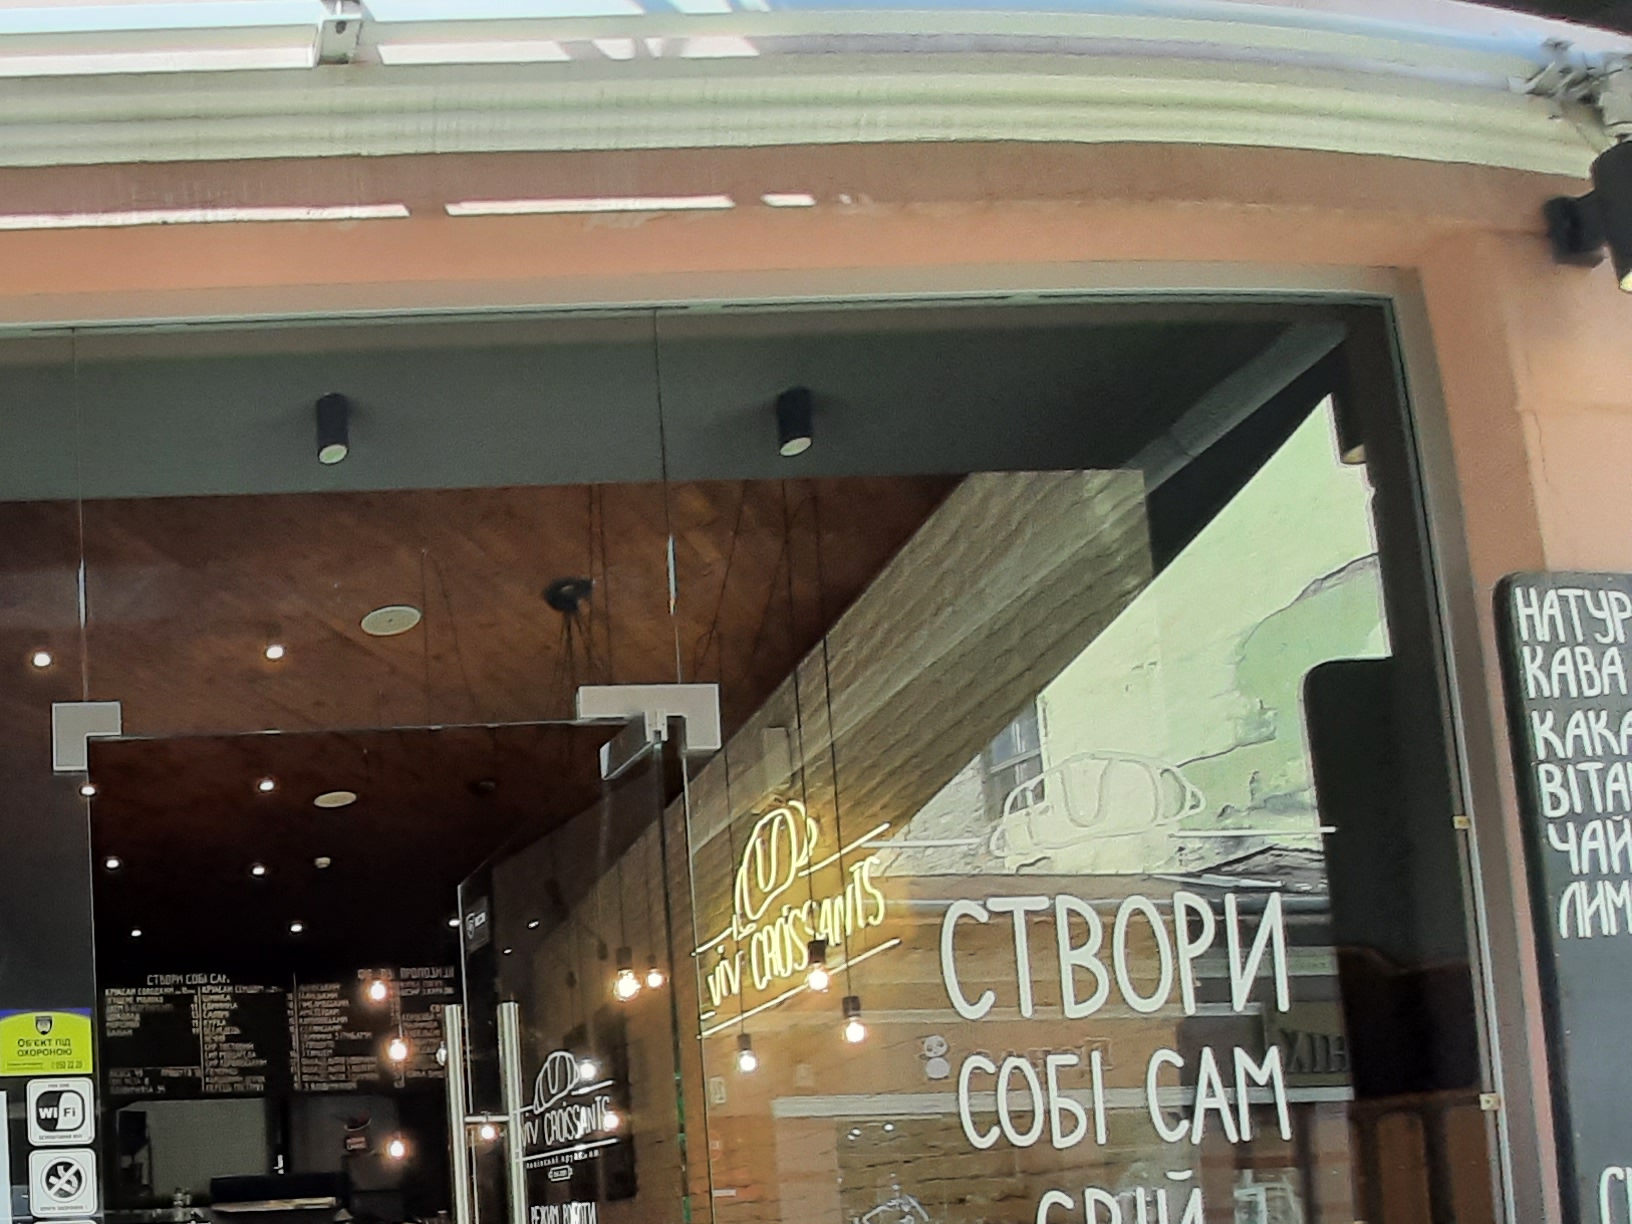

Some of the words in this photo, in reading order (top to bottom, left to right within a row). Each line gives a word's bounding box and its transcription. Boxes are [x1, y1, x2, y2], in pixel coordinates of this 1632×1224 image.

[1522, 646, 1628, 700] КАВА
[941, 892, 1290, 1020] СТВОРИ
[17, 1048, 72, 1057] ОХОРОНОЮ
[958, 1049, 1108, 1150] СОБІ
[1146, 1045, 1292, 1145] САМ
